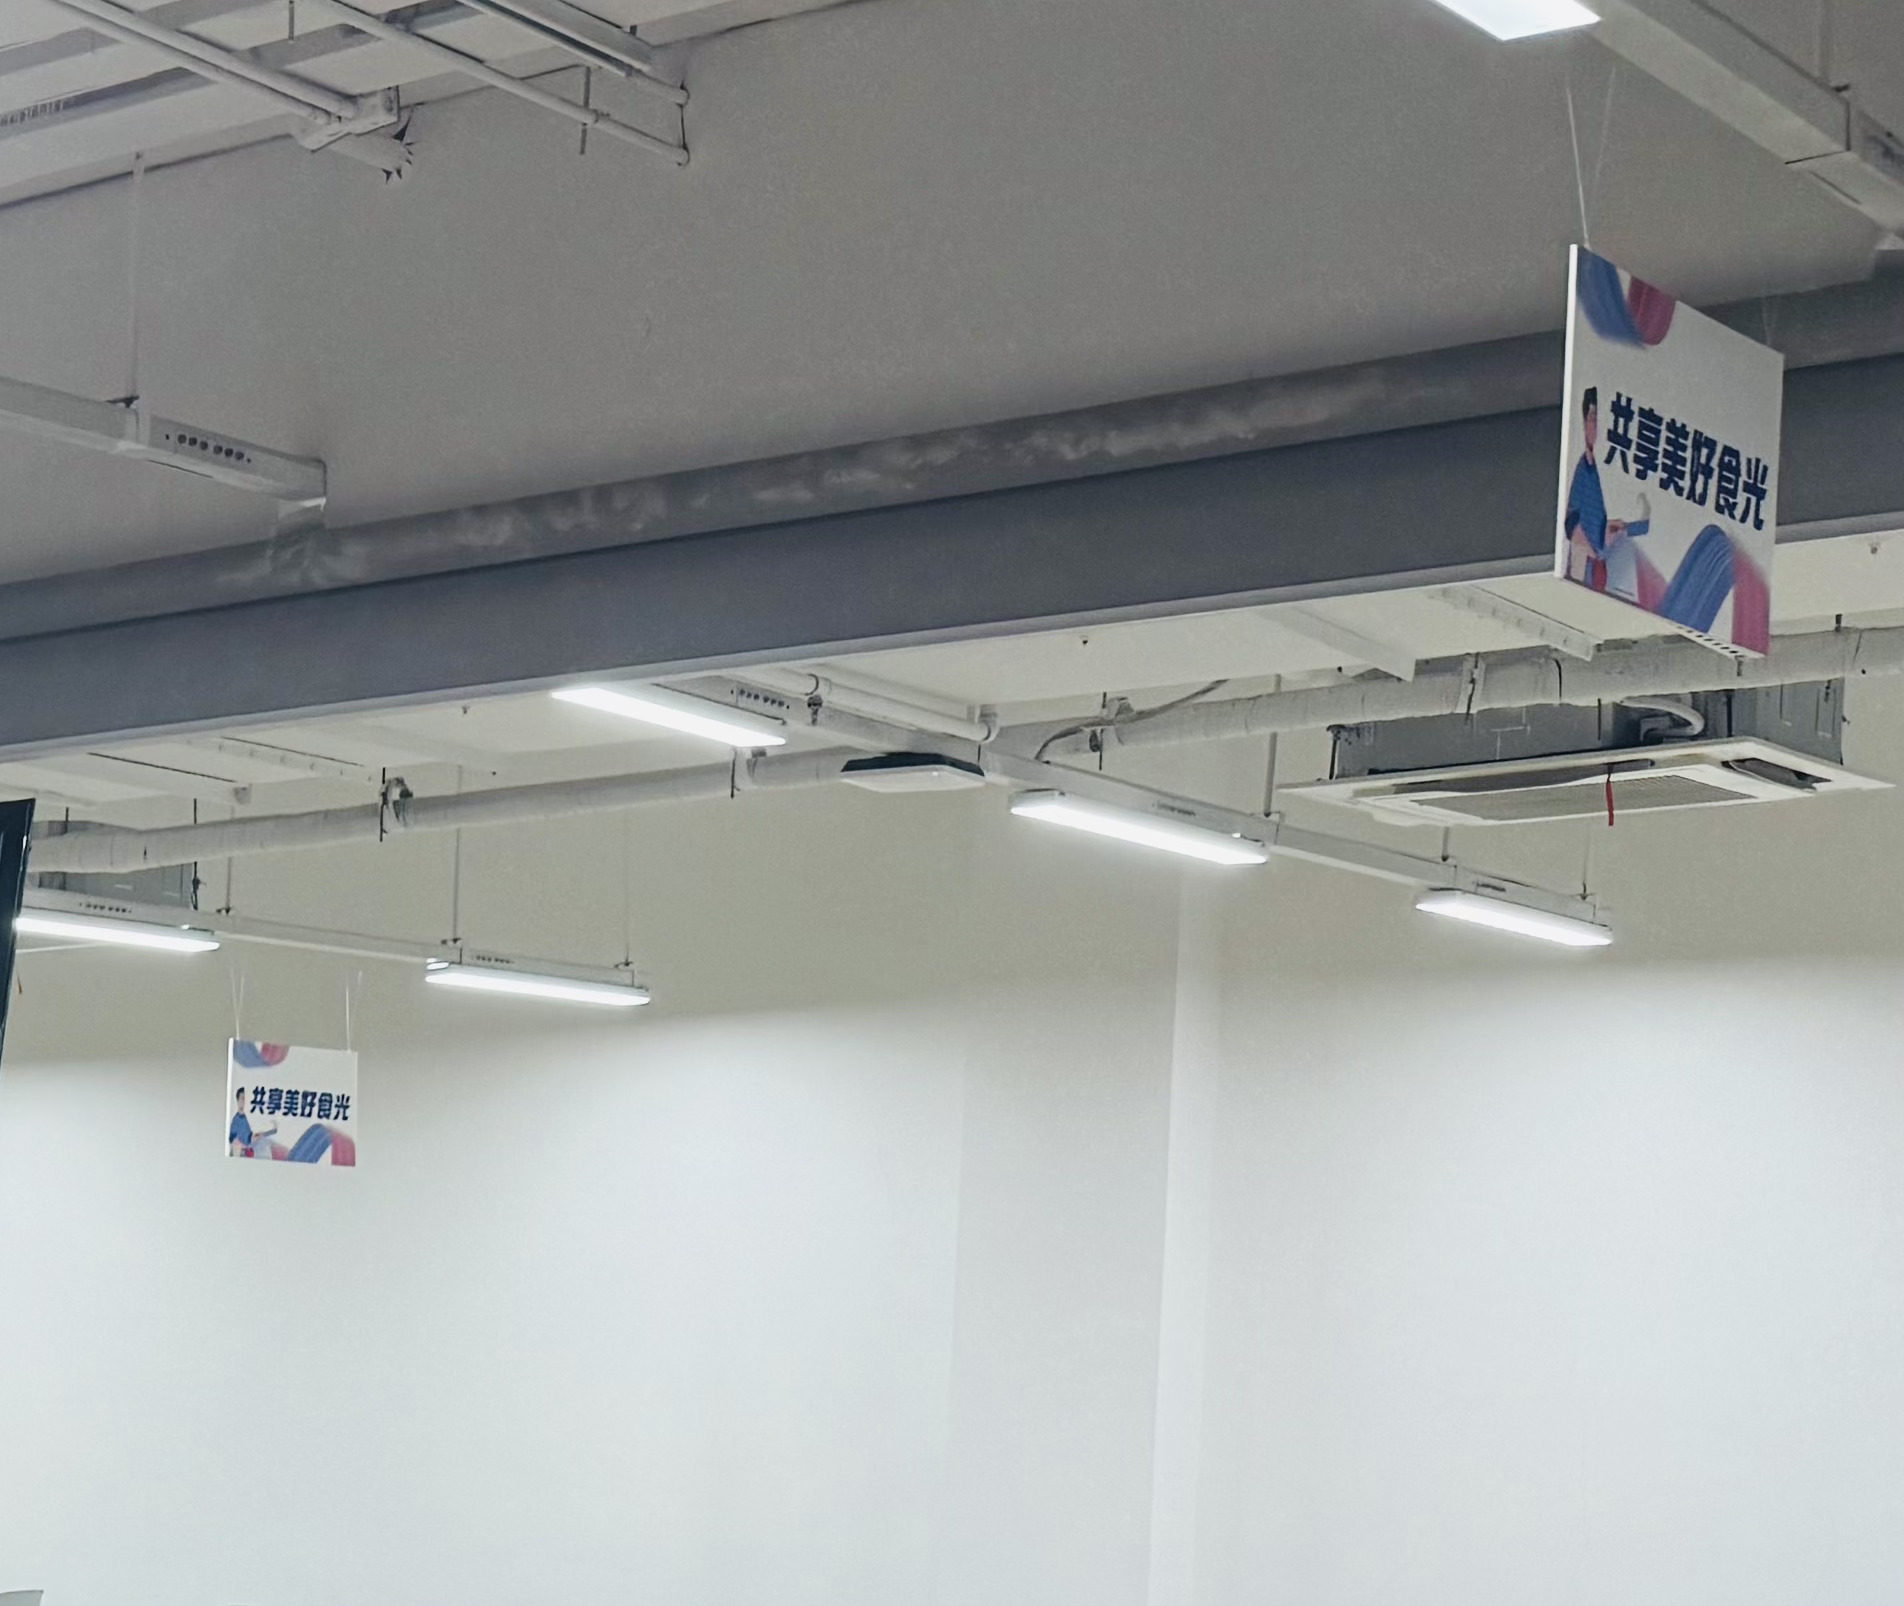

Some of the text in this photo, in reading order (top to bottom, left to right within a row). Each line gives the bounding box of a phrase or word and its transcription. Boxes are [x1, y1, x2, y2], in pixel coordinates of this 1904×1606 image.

[1604, 391, 1769, 530] 共享美好食光
[250, 1086, 351, 1121] 共享美好食光
